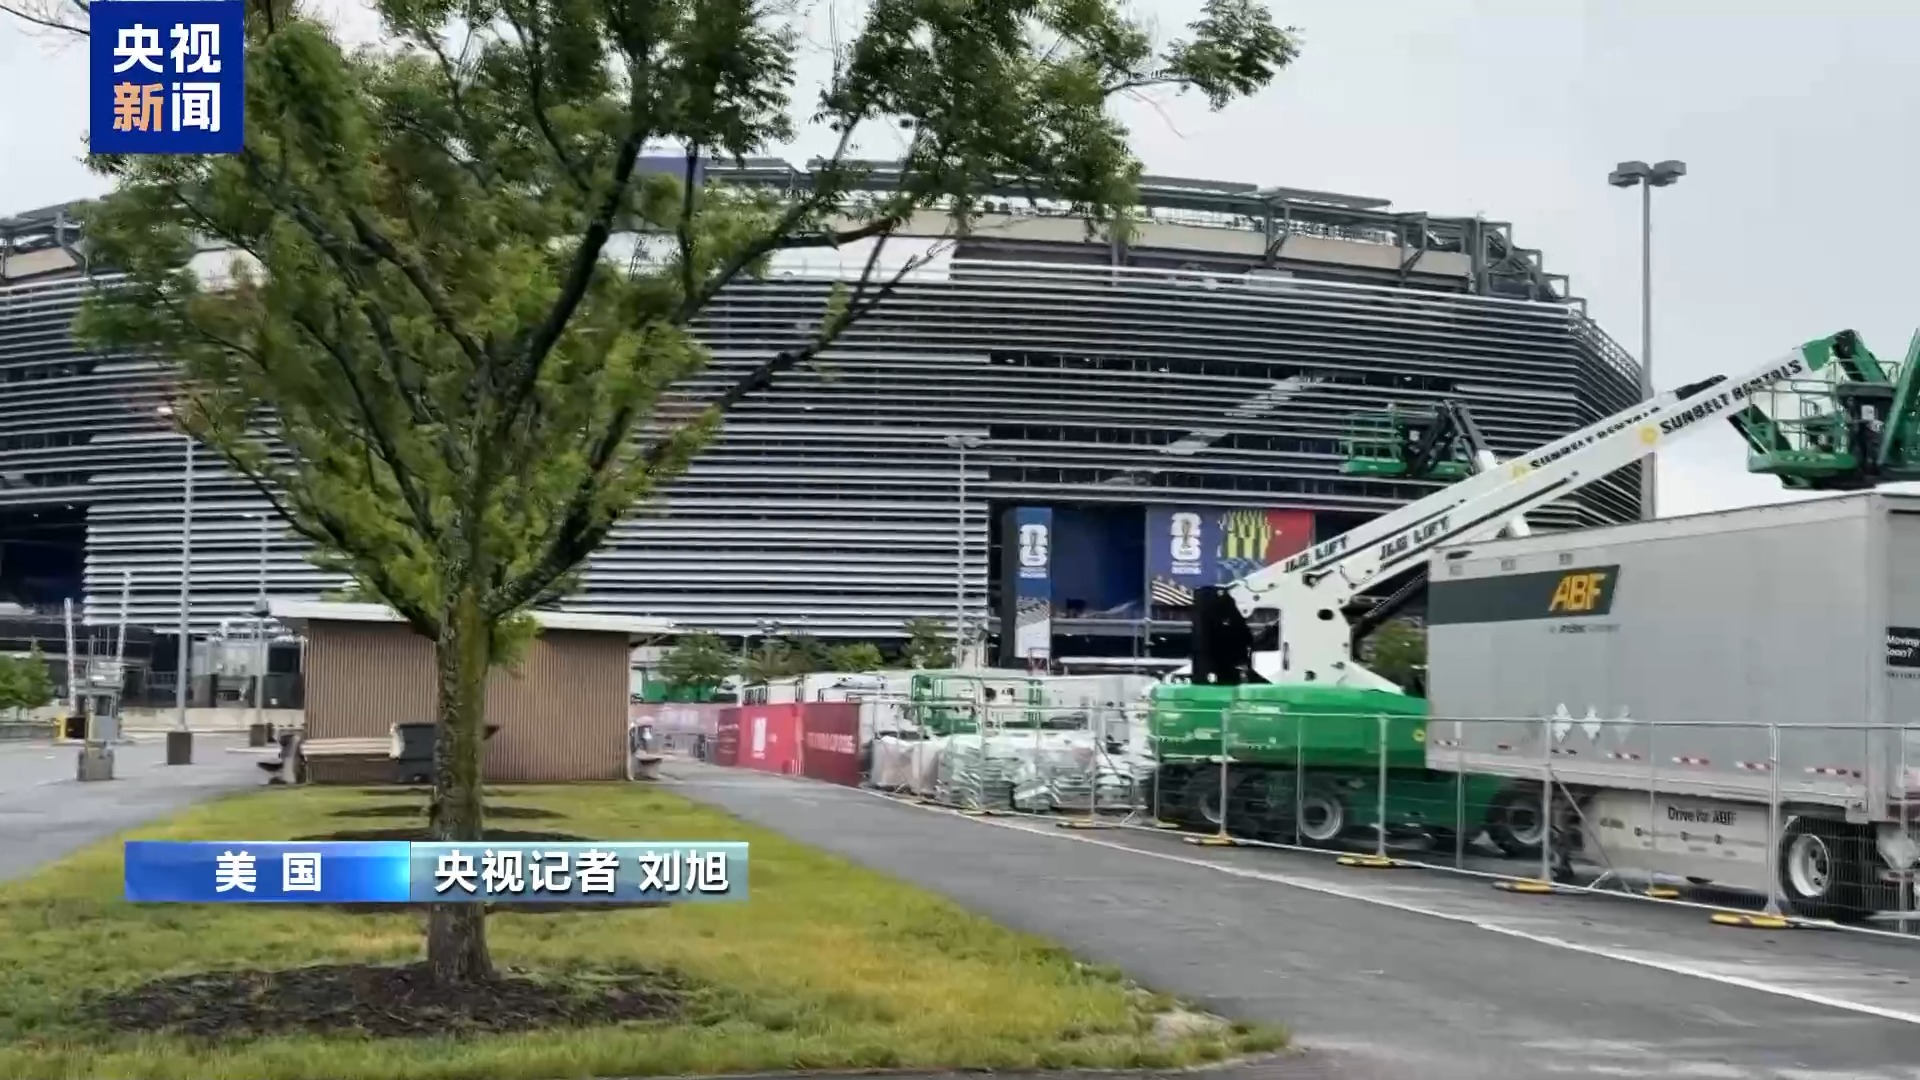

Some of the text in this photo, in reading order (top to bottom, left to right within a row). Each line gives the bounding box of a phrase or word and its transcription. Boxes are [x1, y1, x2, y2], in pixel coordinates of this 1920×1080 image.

[1660, 393, 1730, 434] SUNBELT
[1315, 534, 1348, 561] LIFT
[1379, 515, 1450, 561] JLG LIFT
[1548, 572, 1607, 612] ABF
